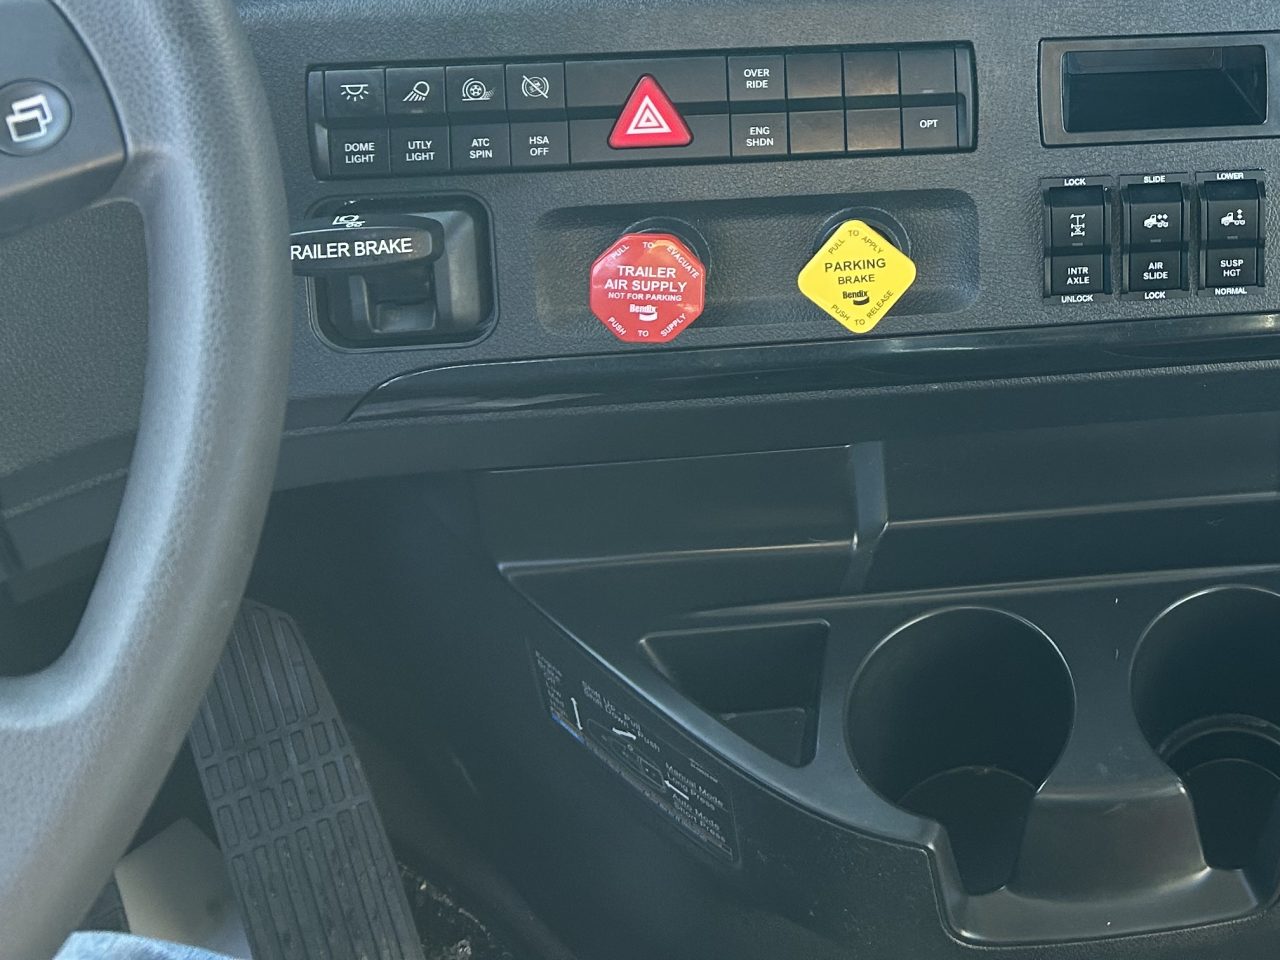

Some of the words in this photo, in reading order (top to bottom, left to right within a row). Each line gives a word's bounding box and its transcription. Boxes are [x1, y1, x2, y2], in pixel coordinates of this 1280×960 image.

[743, 68, 770, 78] OVER
[746, 80, 769, 89] RIDE
[919, 118, 938, 128] OPT
[750, 126, 770, 136] ENG
[408, 140, 432, 150] UTLY
[471, 138, 490, 147] ATC
[529, 136, 549, 145] HSA
[746, 137, 774, 147] SHDN
[344, 142, 375, 152] DOME
[530, 147, 549, 157] OFF
[345, 154, 375, 164] LIGHT
[405, 152, 435, 161] LIGHT
[469, 149, 492, 159] SPIN
[1143, 175, 1166, 183] SLIDE
[1216, 172, 1244, 180] LOWER
[1064, 178, 1086, 186] LOCK
[828, 239, 846, 255] PULL
[848, 229, 860, 237] TO
[861, 235, 884, 254] APPLY
[290, 243, 351, 261] RAILER
[354, 238, 413, 257] BRAKE
[612, 245, 629, 261] PULL
[642, 241, 654, 249] TO
[666, 245, 700, 279] EVACUATE
[824, 257, 886, 273] PARKING
[1220, 259, 1244, 268] SUSP
[1067, 266, 1089, 275] INTR
[1148, 262, 1164, 270] AIR
[617, 265, 676, 278] TRAILER
[1143, 271, 1168, 280] SLIDE
[1223, 268, 1241, 277] HGT
[838, 273, 876, 285] BRAKE
[1066, 276, 1090, 285] AXLE
[604, 279, 628, 290] AIR
[632, 280, 688, 293] SUPPLY
[842, 289, 868, 300] Bendix
[1144, 291, 1166, 300] LOCK
[1215, 287, 1247, 296] NORMAL
[645, 293, 682, 302] PARKING
[1061, 294, 1094, 303] UNLOCK
[629, 303, 658, 313] Bendix
[831, 304, 850, 321] PUSH
[866, 290, 894, 319] RELEASE
[607, 316, 627, 336] PUSH
[637, 329, 649, 337] TO
[660, 312, 687, 337] SUPPLY
